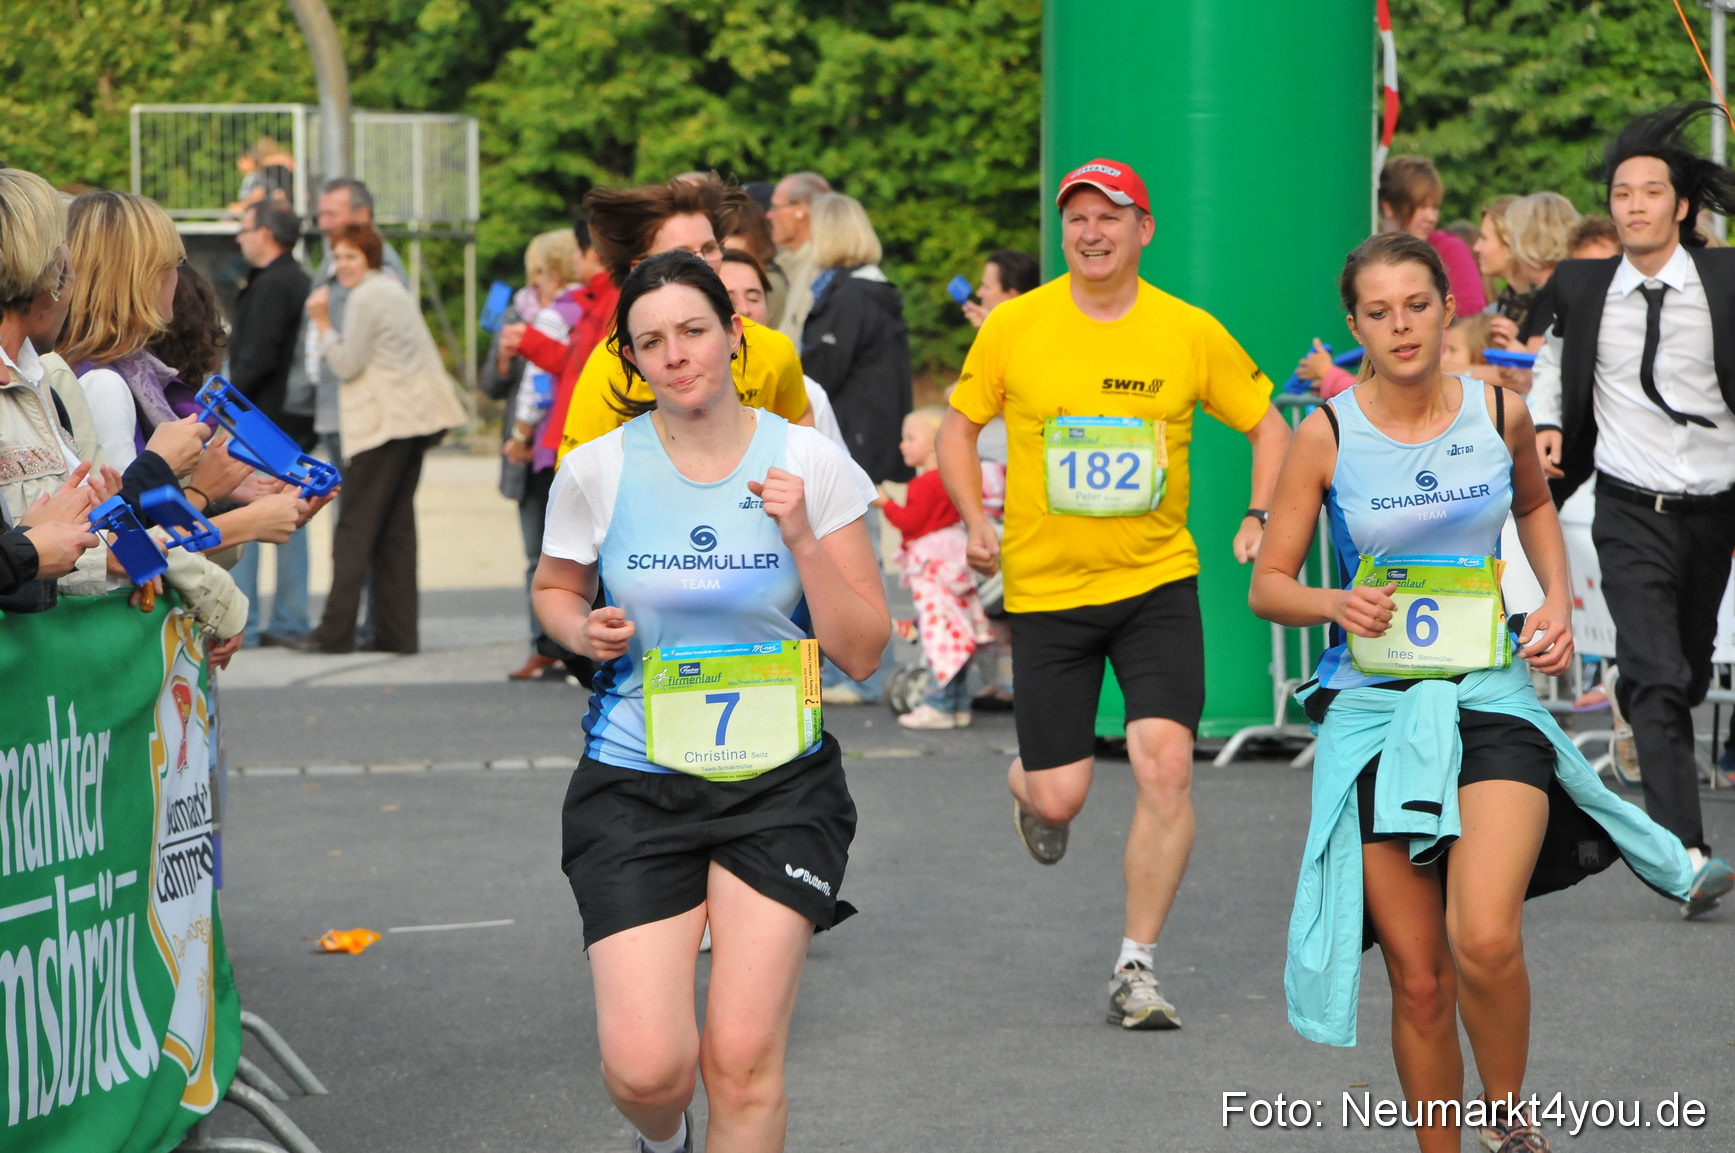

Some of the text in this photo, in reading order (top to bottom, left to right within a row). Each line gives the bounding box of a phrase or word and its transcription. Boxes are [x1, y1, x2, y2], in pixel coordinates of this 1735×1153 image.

[1102, 378, 1145, 391] swn
[1059, 451, 1140, 490] 182
[1371, 484, 1491, 511] SCHABMÜLLER
[1416, 510, 1447, 521] TEAM
[626, 553, 780, 571] SCHABMÜLLER
[681, 578, 721, 590] TEAM
[1406, 597, 1440, 648] 6
[1387, 648, 1454, 663] Ines Sammüller
[668, 672, 722, 686] firmenlauf
[705, 692, 740, 746] 7
[684, 749, 769, 764] Christina Seitz
[718, 763, 753, 771] Schabmüller
